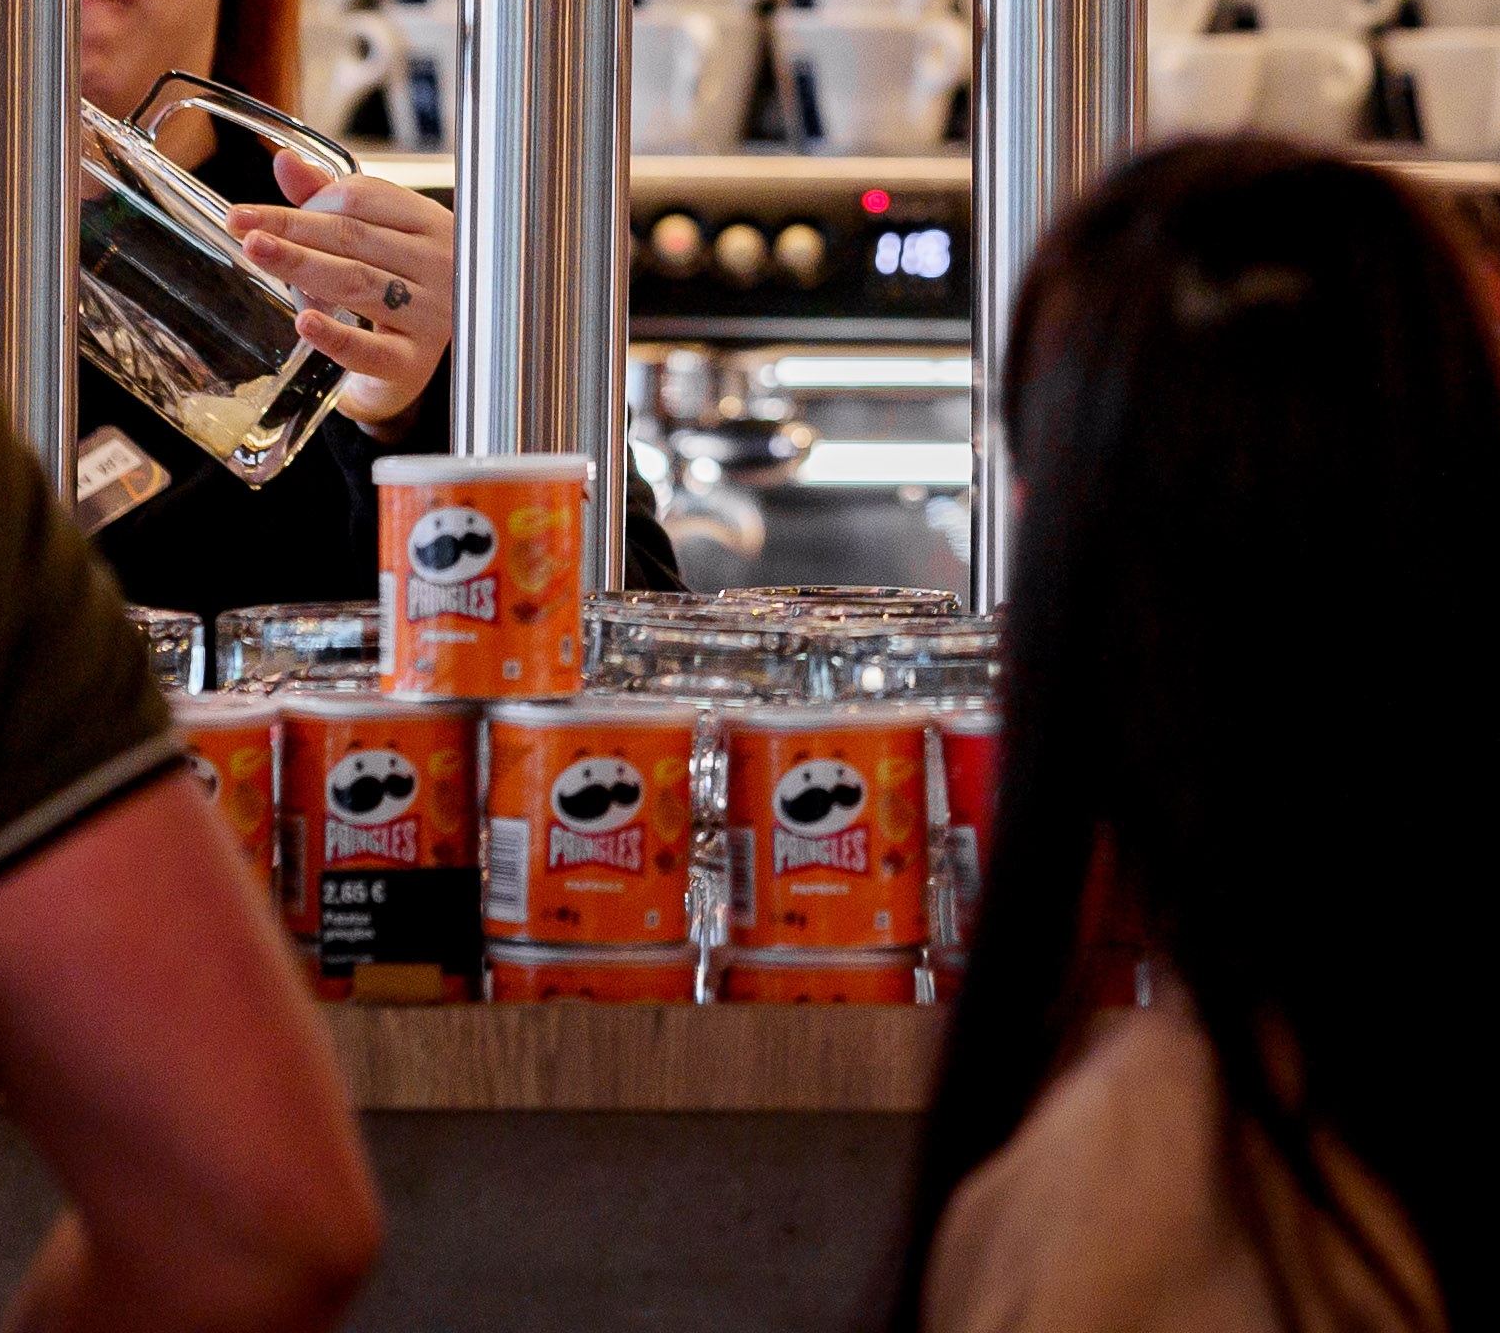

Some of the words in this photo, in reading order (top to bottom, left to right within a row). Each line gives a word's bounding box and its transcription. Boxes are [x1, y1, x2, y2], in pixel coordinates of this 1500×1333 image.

[407, 574, 495, 621] PRINGLES
[550, 824, 642, 871] PRINGLES
[774, 824, 867, 874] PRINGLES
